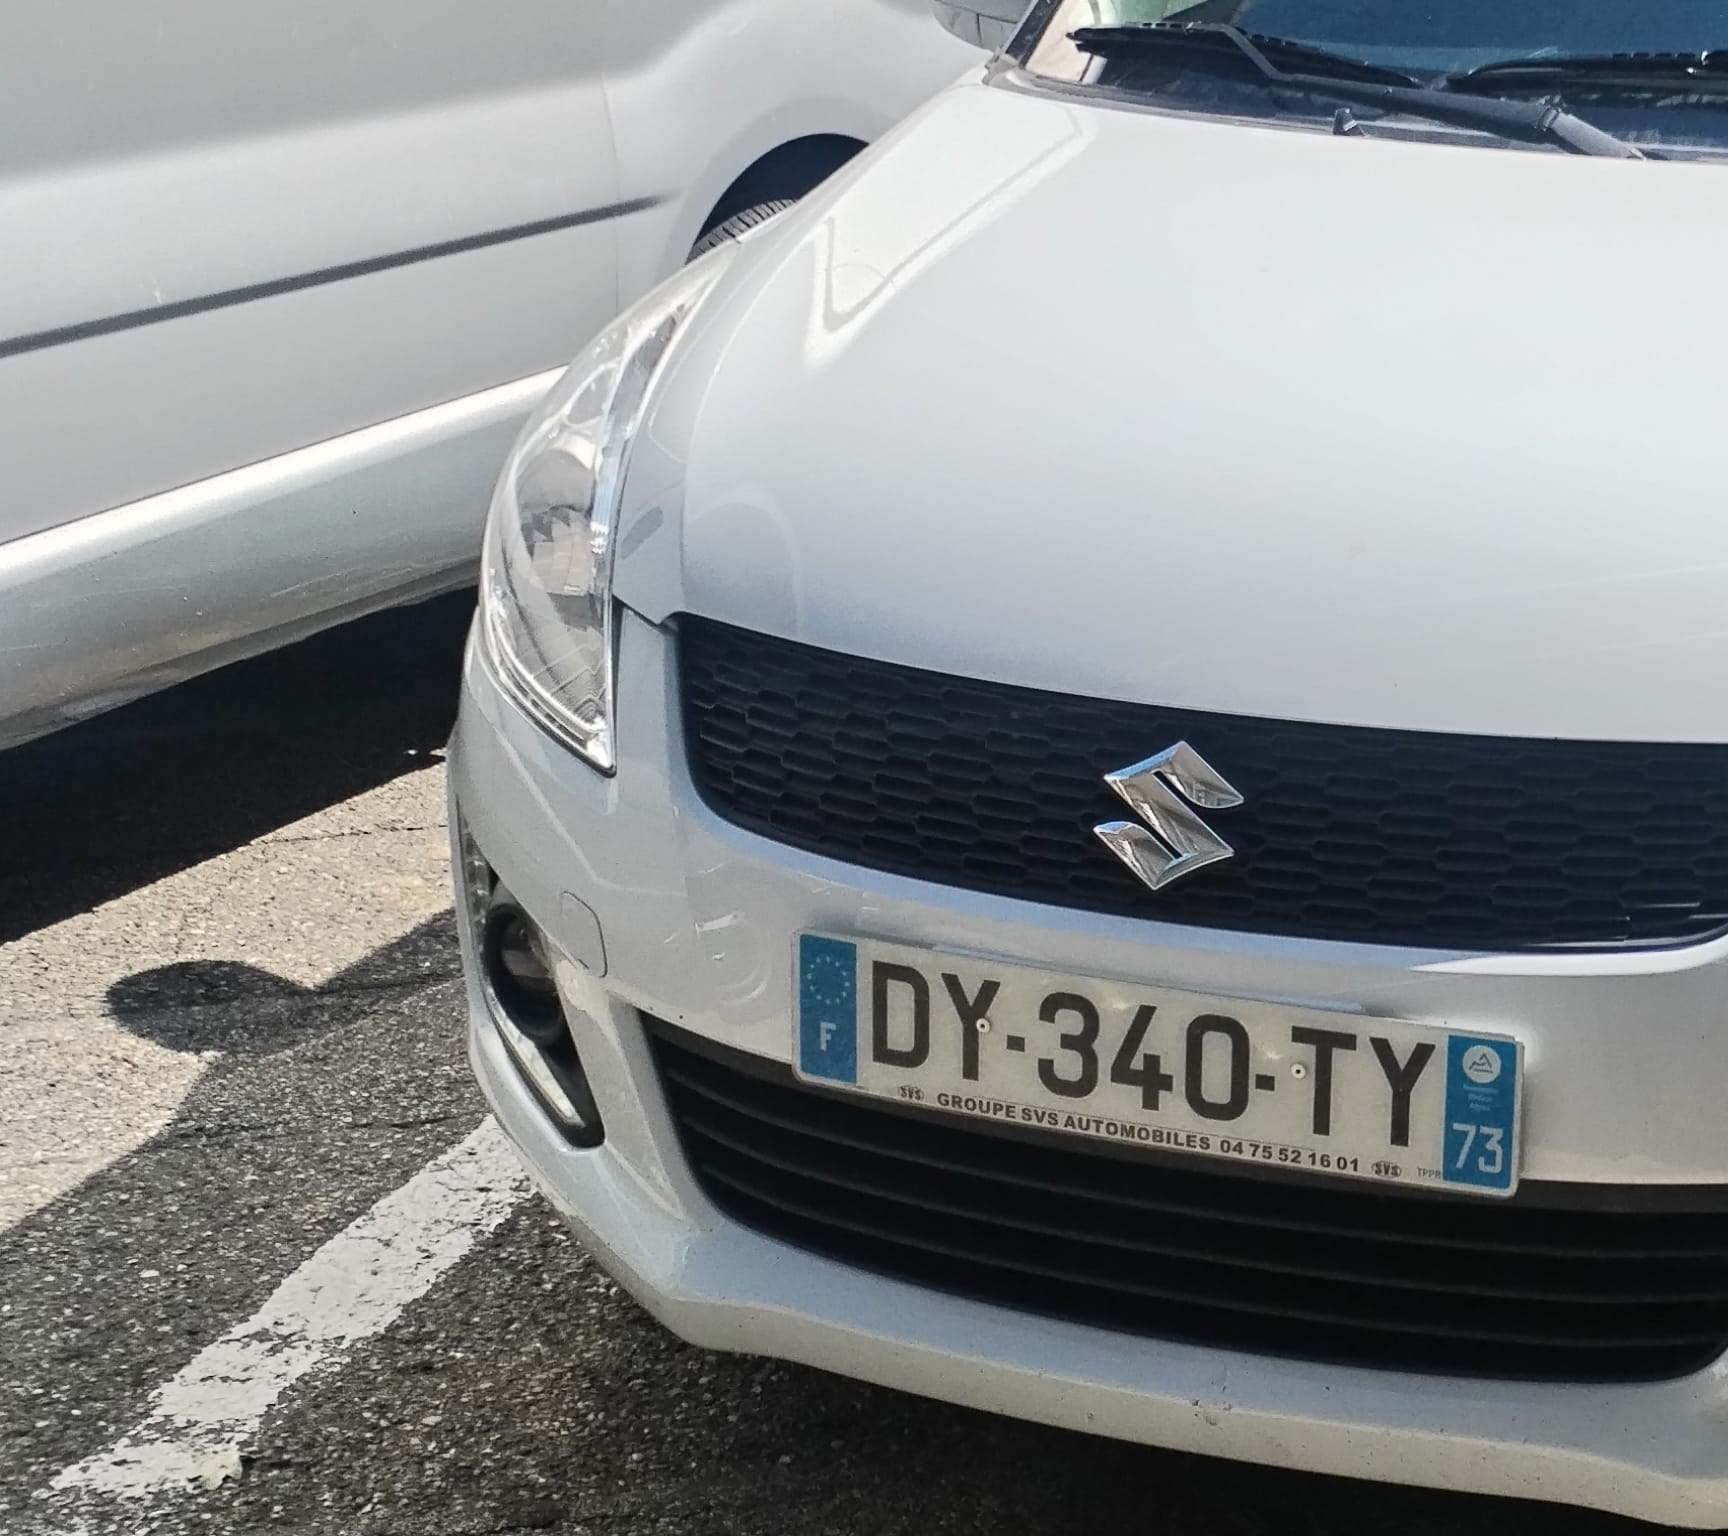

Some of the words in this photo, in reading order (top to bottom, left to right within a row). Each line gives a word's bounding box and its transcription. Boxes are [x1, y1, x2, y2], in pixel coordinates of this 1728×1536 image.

[819, 1021, 836, 1051] F
[872, 960, 1436, 1147] DY-340-TY
[937, 1092, 1016, 1119] GROUPE
[1021, 1107, 1059, 1126] SVS
[1063, 1114, 1211, 1151] AUTOMOBILES
[1220, 1138, 1244, 1156] 04
[1249, 1142, 1273, 1160] 75
[1278, 1147, 1302, 1164] 52
[1307, 1151, 1331, 1169] 16
[1336, 1156, 1359, 1173] 01
[1452, 1122, 1503, 1174] 73
